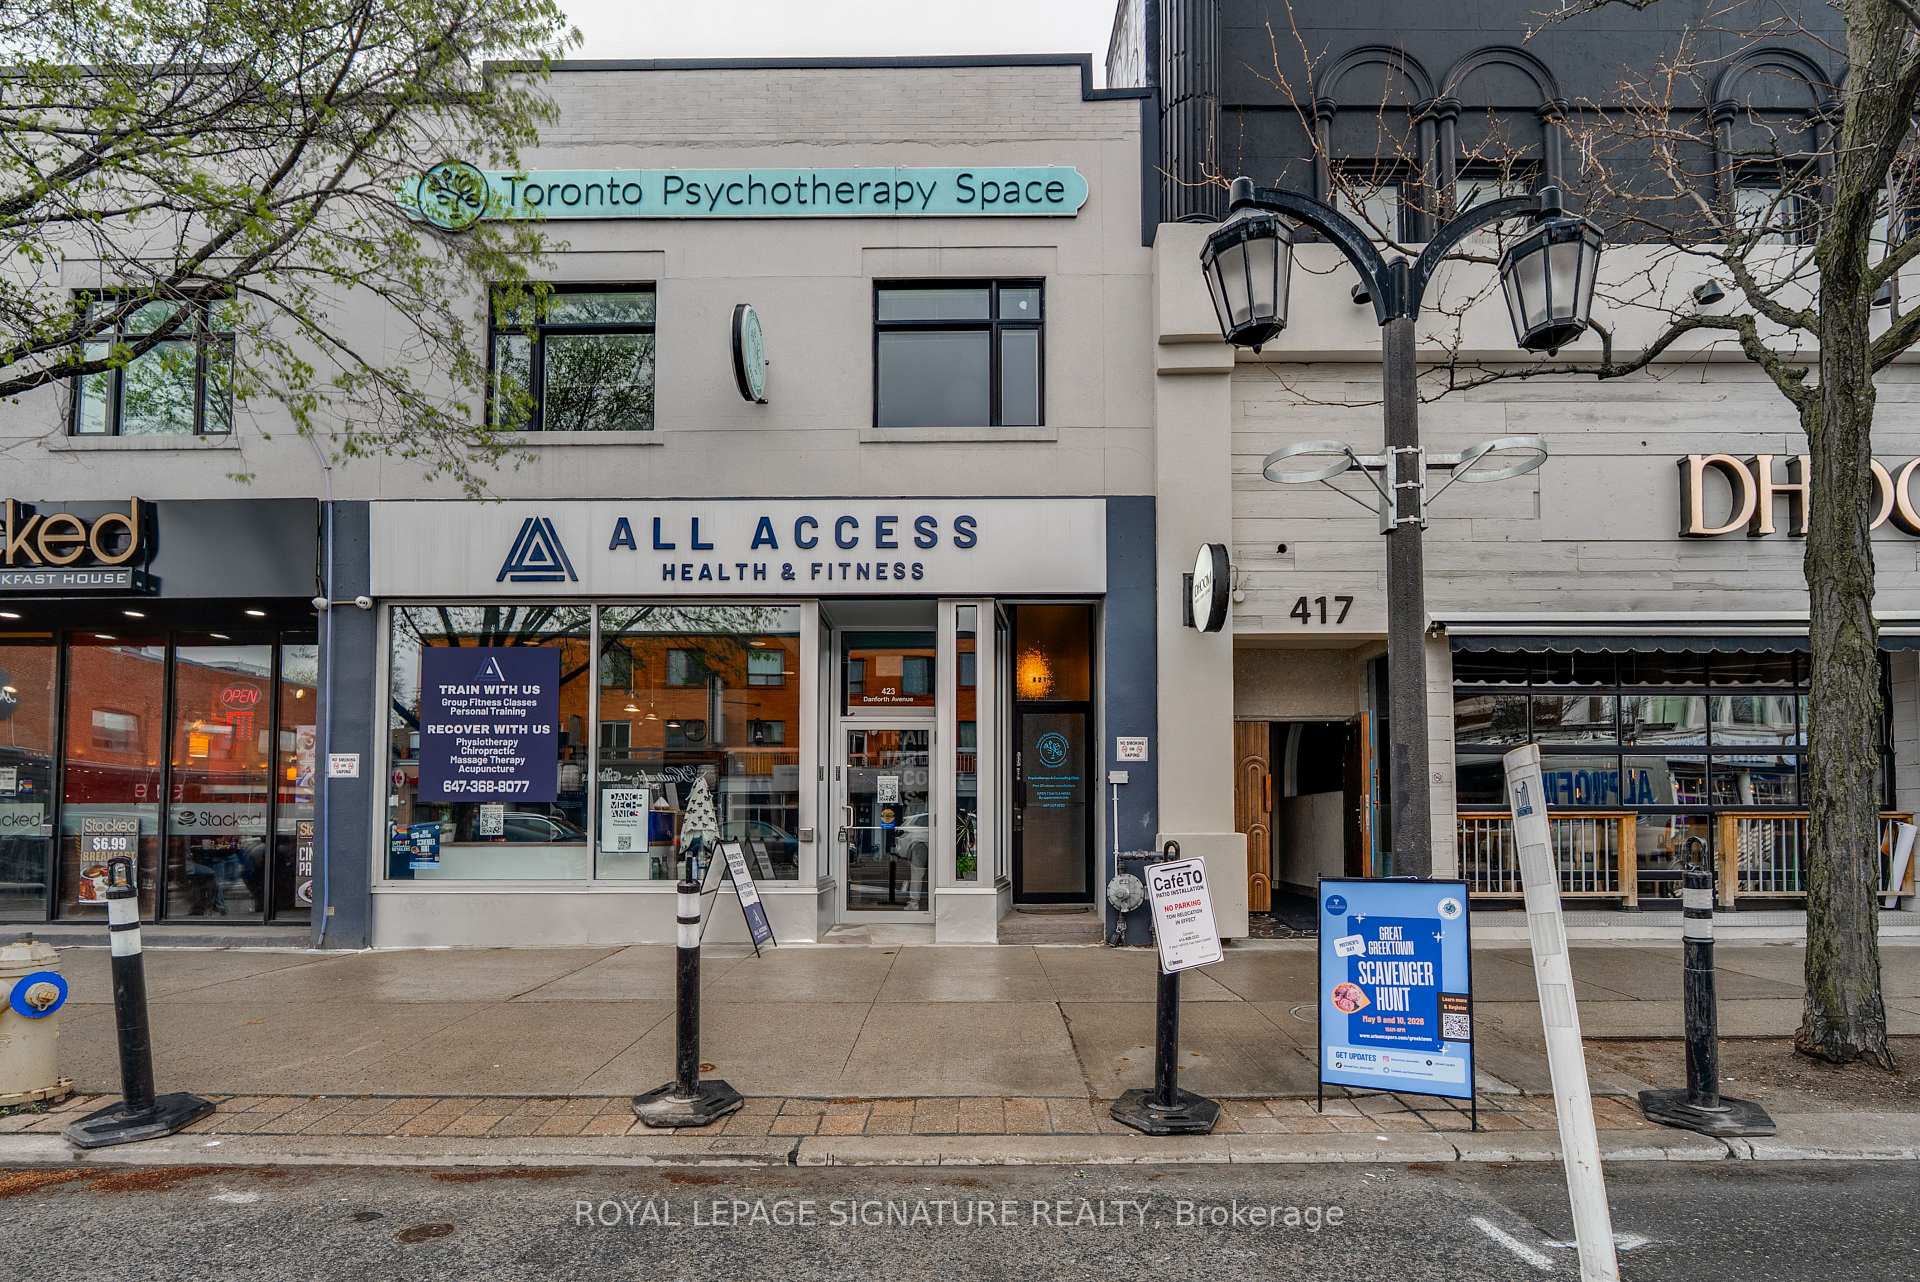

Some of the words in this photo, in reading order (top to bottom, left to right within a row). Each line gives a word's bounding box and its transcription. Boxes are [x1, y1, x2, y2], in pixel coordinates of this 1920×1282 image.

[501, 176, 643, 206] Toronto
[664, 174, 937, 212] Psychotherapy
[956, 173, 1065, 210] Space
[0, 496, 138, 566] ked
[609, 517, 714, 551] ALL
[751, 516, 978, 549] ACCESS
[663, 563, 767, 581] HEALTH
[781, 563, 796, 580] &
[811, 562, 925, 580] FITNESS
[63, 573, 127, 584] HOUSE
[1290, 595, 1354, 624] 417
[439, 685, 480, 694] TRAIN
[484, 685, 518, 694] WITH
[522, 685, 541, 694] US
[881, 687, 896, 695] 423
[223, 689, 258, 703] OPEN
[441, 698, 468, 707] Group
[469, 698, 501, 706] Fitness
[503, 698, 537, 706] Classes
[450, 707, 489, 715] Personal
[491, 707, 526, 717] Training
[427, 725, 489, 734] RECOVER
[494, 725, 528, 734] WITH
[533, 725, 551, 734] US
[456, 738, 518, 747] Physiotherapy
[461, 747, 515, 756] Chiropractic
[450, 756, 488, 765] Massage
[490, 756, 525, 766] Therapy
[458, 765, 515, 774] Acupuncture
[443, 781, 530, 792] 647-368-8077
[0, 812, 41, 827] cked
[84, 818, 137, 832] Stacked
[200, 811, 262, 827] Stacked
[93, 837, 127, 850] $6.99
[1154, 870, 1203, 891] CaféTO
[1171, 885, 1204, 895] INSTALLATION
[1164, 904, 1174, 912] NO
[1175, 899, 1202, 910] PARKING
[1177, 908, 1202, 918] RELOCATION
[1181, 916, 1196, 924] EFFECT
[1379, 926, 1403, 940] GREAT
[1368, 941, 1414, 955] GREEKTOWN
[1358, 961, 1434, 986] SCAVENGER
[1376, 987, 1410, 1012] HUNT
[1362, 1015, 1376, 1024] May
[1335, 1051, 1348, 1059] GET
[1350, 1052, 1377, 1062] UPDATES
